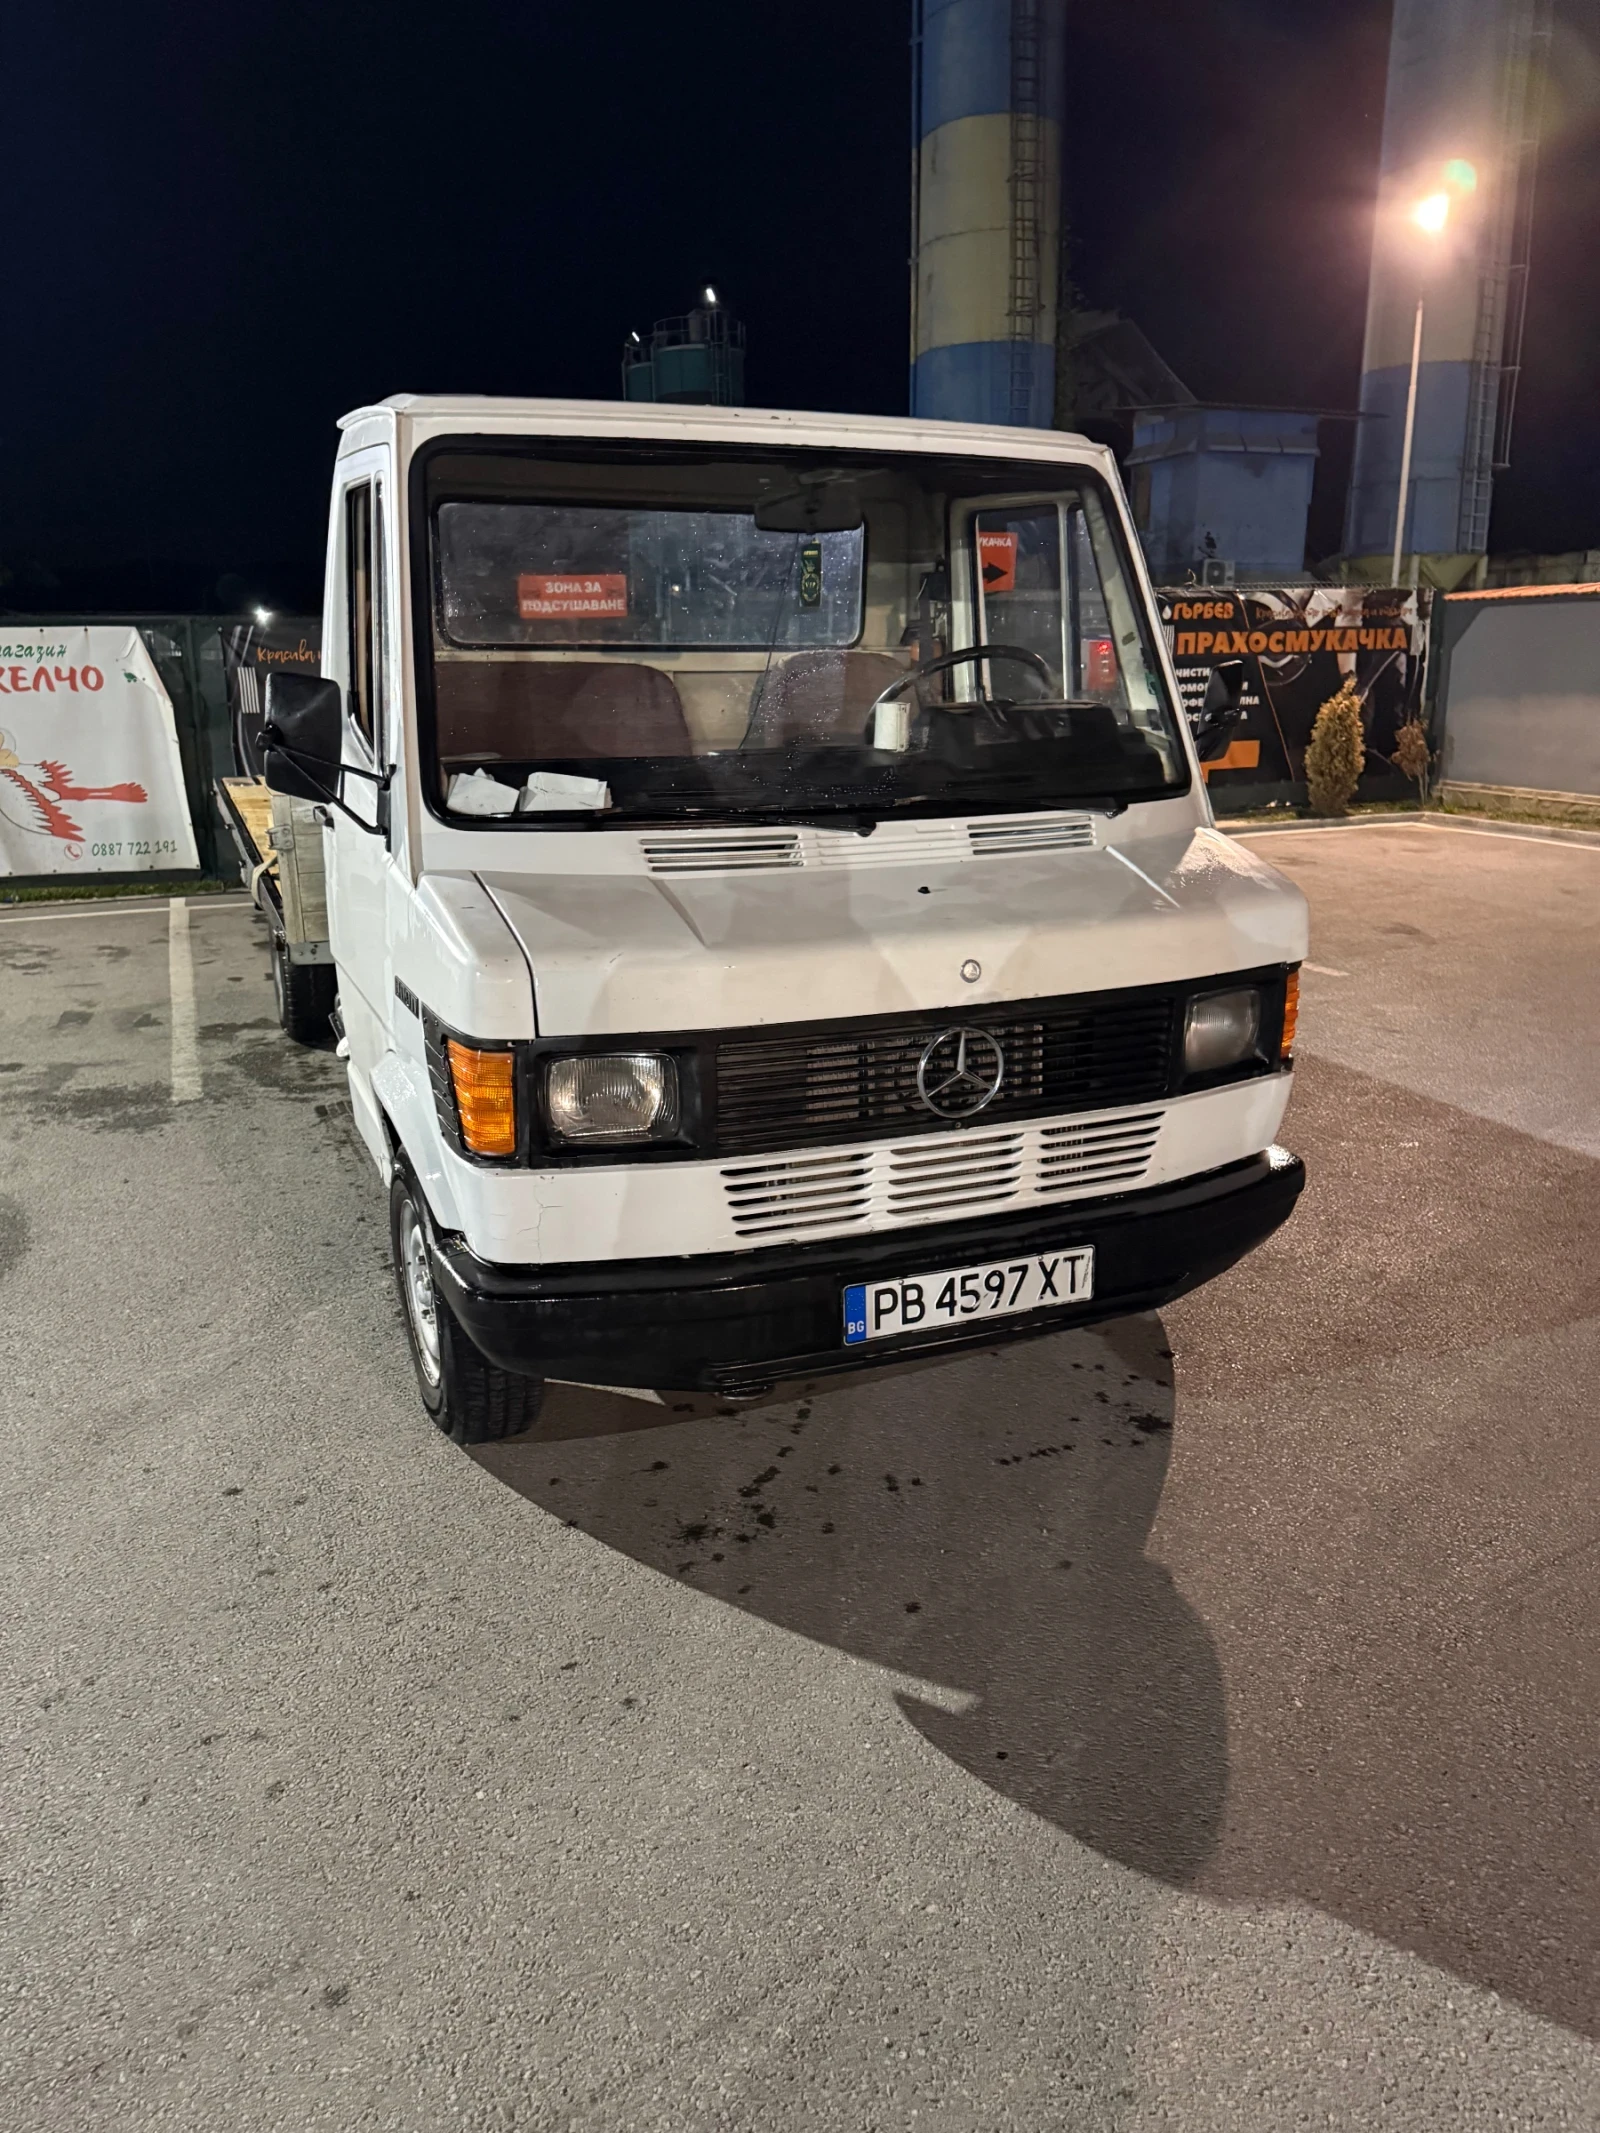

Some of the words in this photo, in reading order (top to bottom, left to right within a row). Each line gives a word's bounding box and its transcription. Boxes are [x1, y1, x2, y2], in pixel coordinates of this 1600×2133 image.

[545, 581, 582, 594] ЗОНА
[584, 581, 602, 593] ЗА
[520, 598, 625, 614] ПОДСУШАВАНЕ
[1172, 601, 1235, 621] ГЪРБЕВ
[1177, 627, 1408, 655] ПРАХОСМУКАЧКА
[0, 644, 67, 664] агазин
[92, 843, 122, 856] 0887
[127, 841, 151, 856] 722
[154, 840, 178, 854] 191
[873, 1283, 925, 1331] PB
[935, 1264, 1029, 1317] 4597
[1037, 1254, 1085, 1301] XT
[847, 1320, 865, 1335] BG
